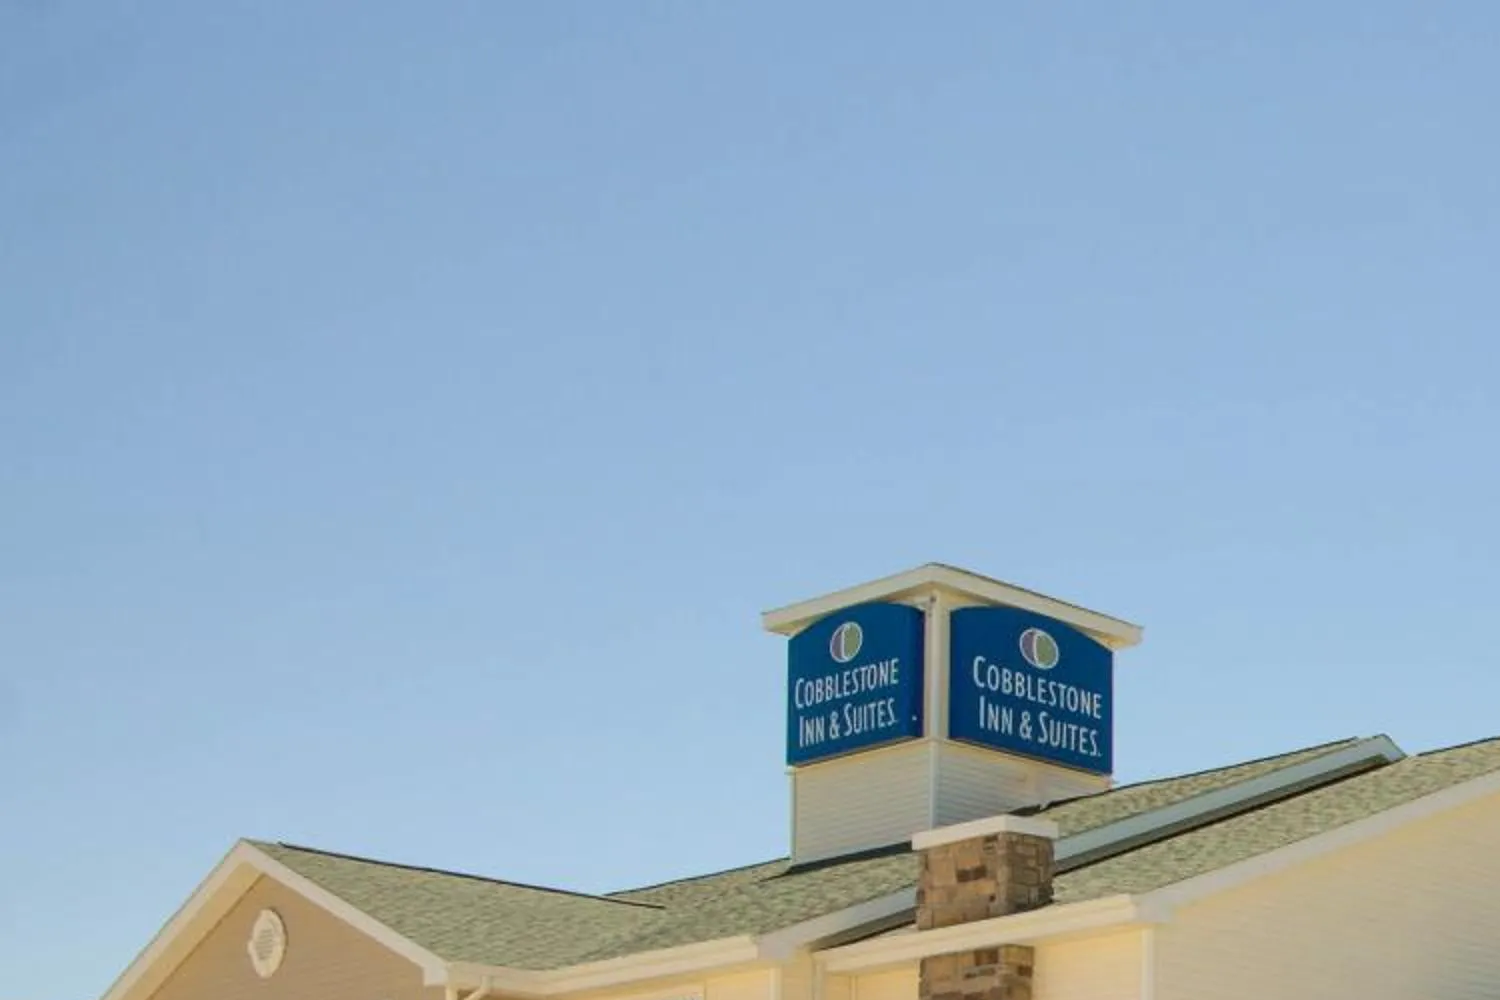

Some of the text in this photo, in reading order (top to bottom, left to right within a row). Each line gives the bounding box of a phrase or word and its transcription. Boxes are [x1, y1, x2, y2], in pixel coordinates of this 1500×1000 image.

[795, 657, 899, 709] COBBLESTONE
[973, 655, 1102, 720] COBBLESTONE
[799, 715, 825, 748] INN
[830, 711, 840, 740] &
[979, 695, 1013, 736] INN
[1020, 710, 1033, 740] &
